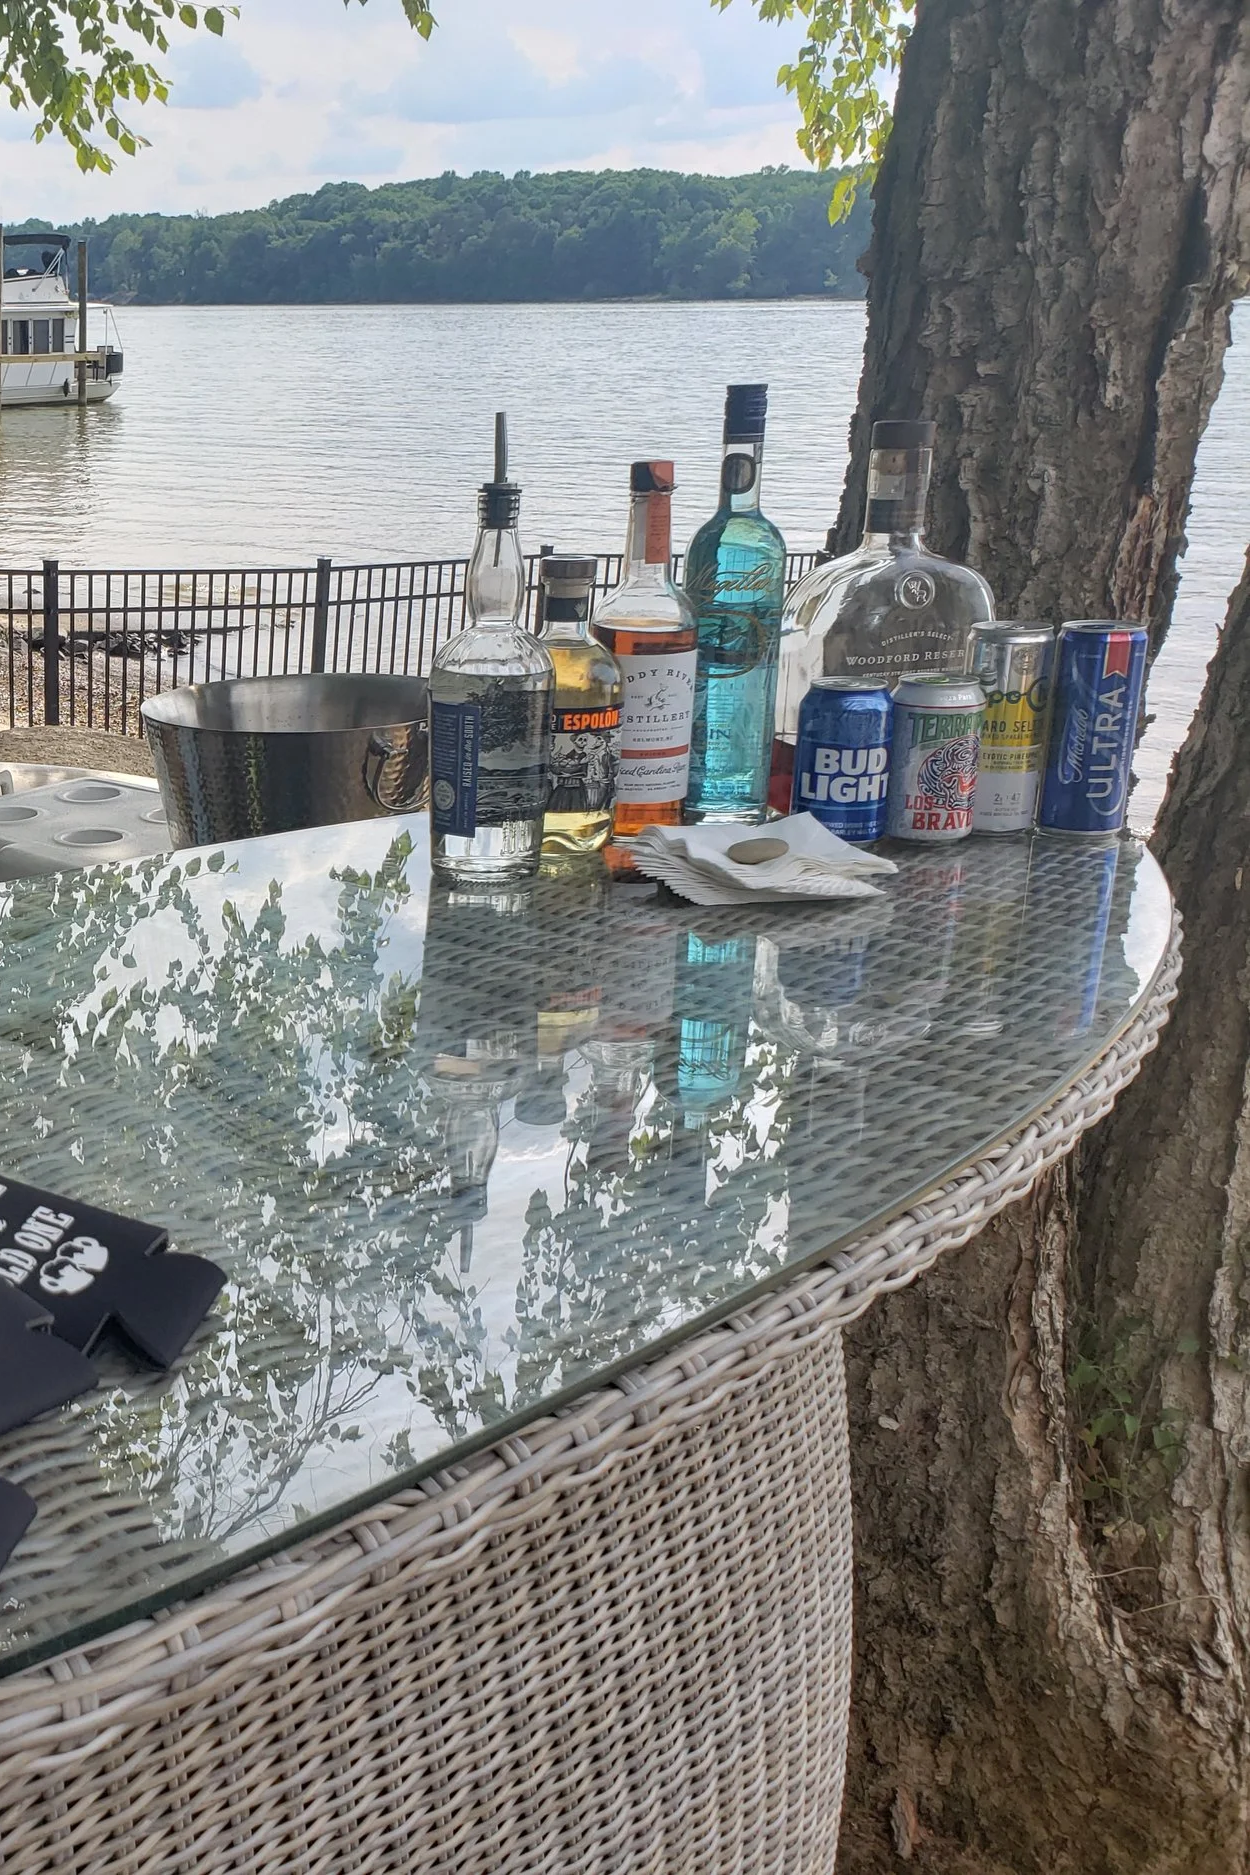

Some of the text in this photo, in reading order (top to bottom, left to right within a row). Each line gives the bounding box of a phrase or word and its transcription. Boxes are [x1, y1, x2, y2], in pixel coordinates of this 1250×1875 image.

[845, 653, 920, 666] WOODFORD
[464, 715, 475, 739] SOUTH
[1062, 707, 1089, 782] Michelob
[1085, 686, 1126, 799] ULTRA
[462, 761, 473, 788] RAISED
[814, 747, 888, 776] BUD
[800, 771, 890, 804] LIGHT
[904, 794, 935, 811] LOS
[14, 1205, 75, 1252] ONE
